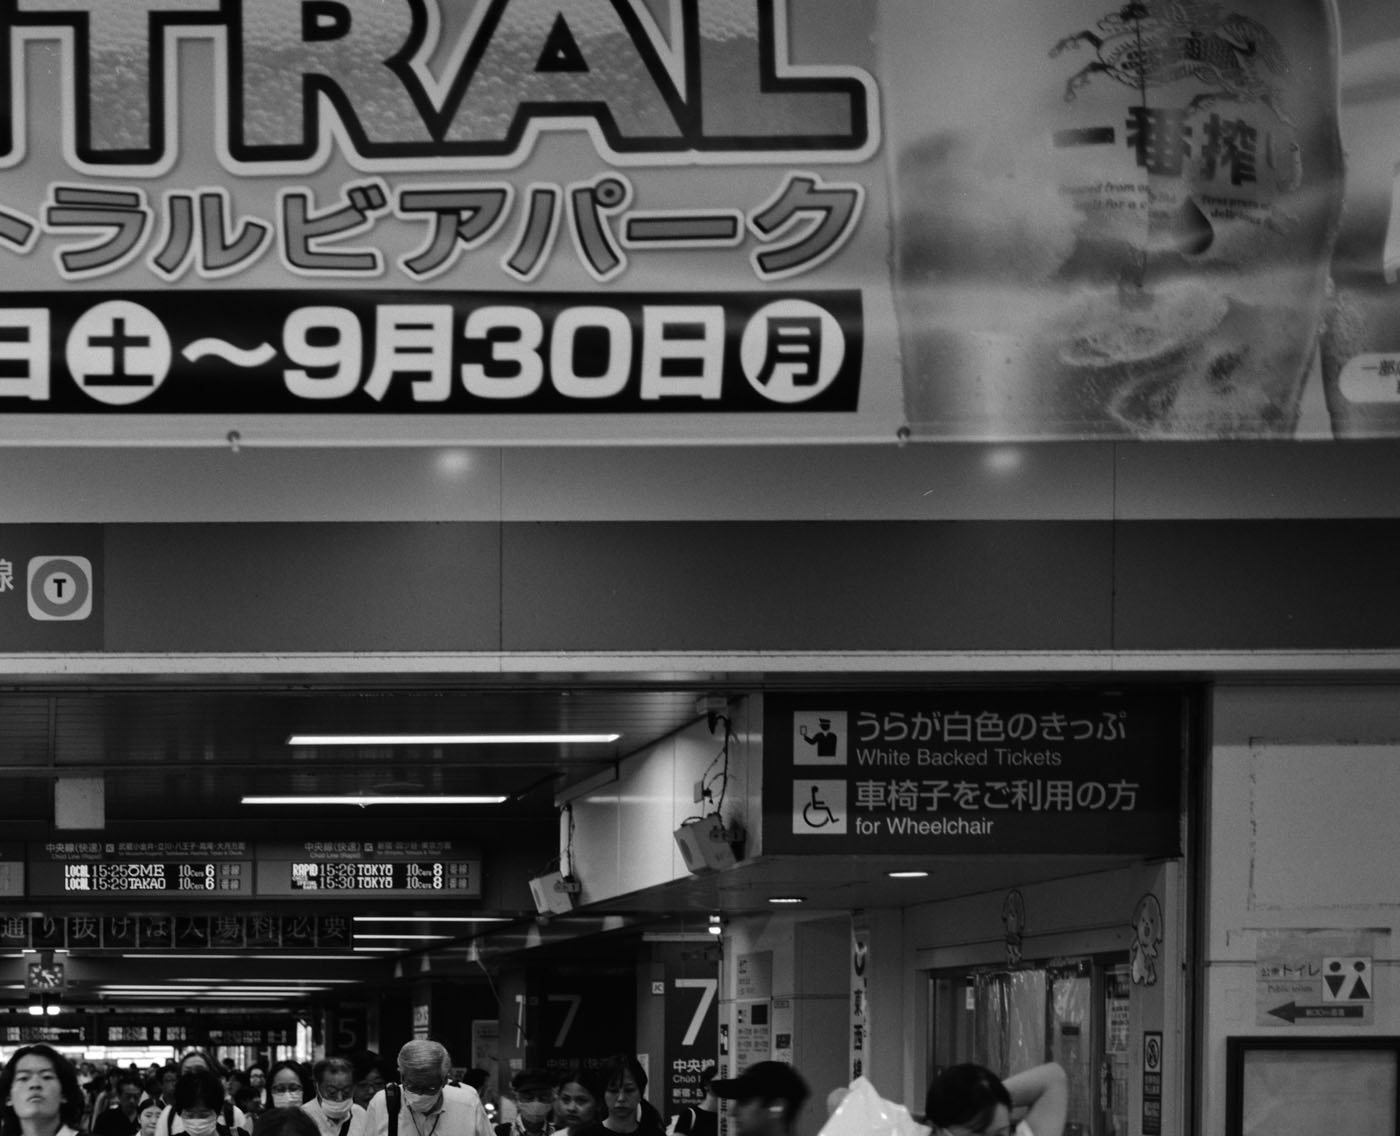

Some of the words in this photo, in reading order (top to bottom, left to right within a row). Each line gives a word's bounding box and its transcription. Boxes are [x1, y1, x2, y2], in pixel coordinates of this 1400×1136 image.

[53, 578, 67, 598] T
[856, 711, 1127, 743] うらが白色のきっぷ
[857, 749, 911, 766] White
[917, 748, 988, 766] Backed
[996, 748, 1062, 766] Tickets
[855, 779, 1140, 811] 車椅子をご利用の方
[855, 817, 881, 834] for
[887, 817, 994, 834] Wheelchair
[65, 864, 91, 878] LOCAL
[92, 864, 128, 878] 15:25
[205, 864, 216, 877] 6
[292, 863, 318, 876] RAPID
[320, 863, 356, 876] 15:26
[432, 863, 443, 876] 8
[65, 878, 91, 890] LOCAL
[92, 878, 128, 890] 15:29
[127, 877, 167, 890] TAKAO
[205, 877, 216, 890] 6
[320, 876, 356, 889] 15:30
[432, 876, 443, 890] 8
[674, 979, 718, 1046] 7
